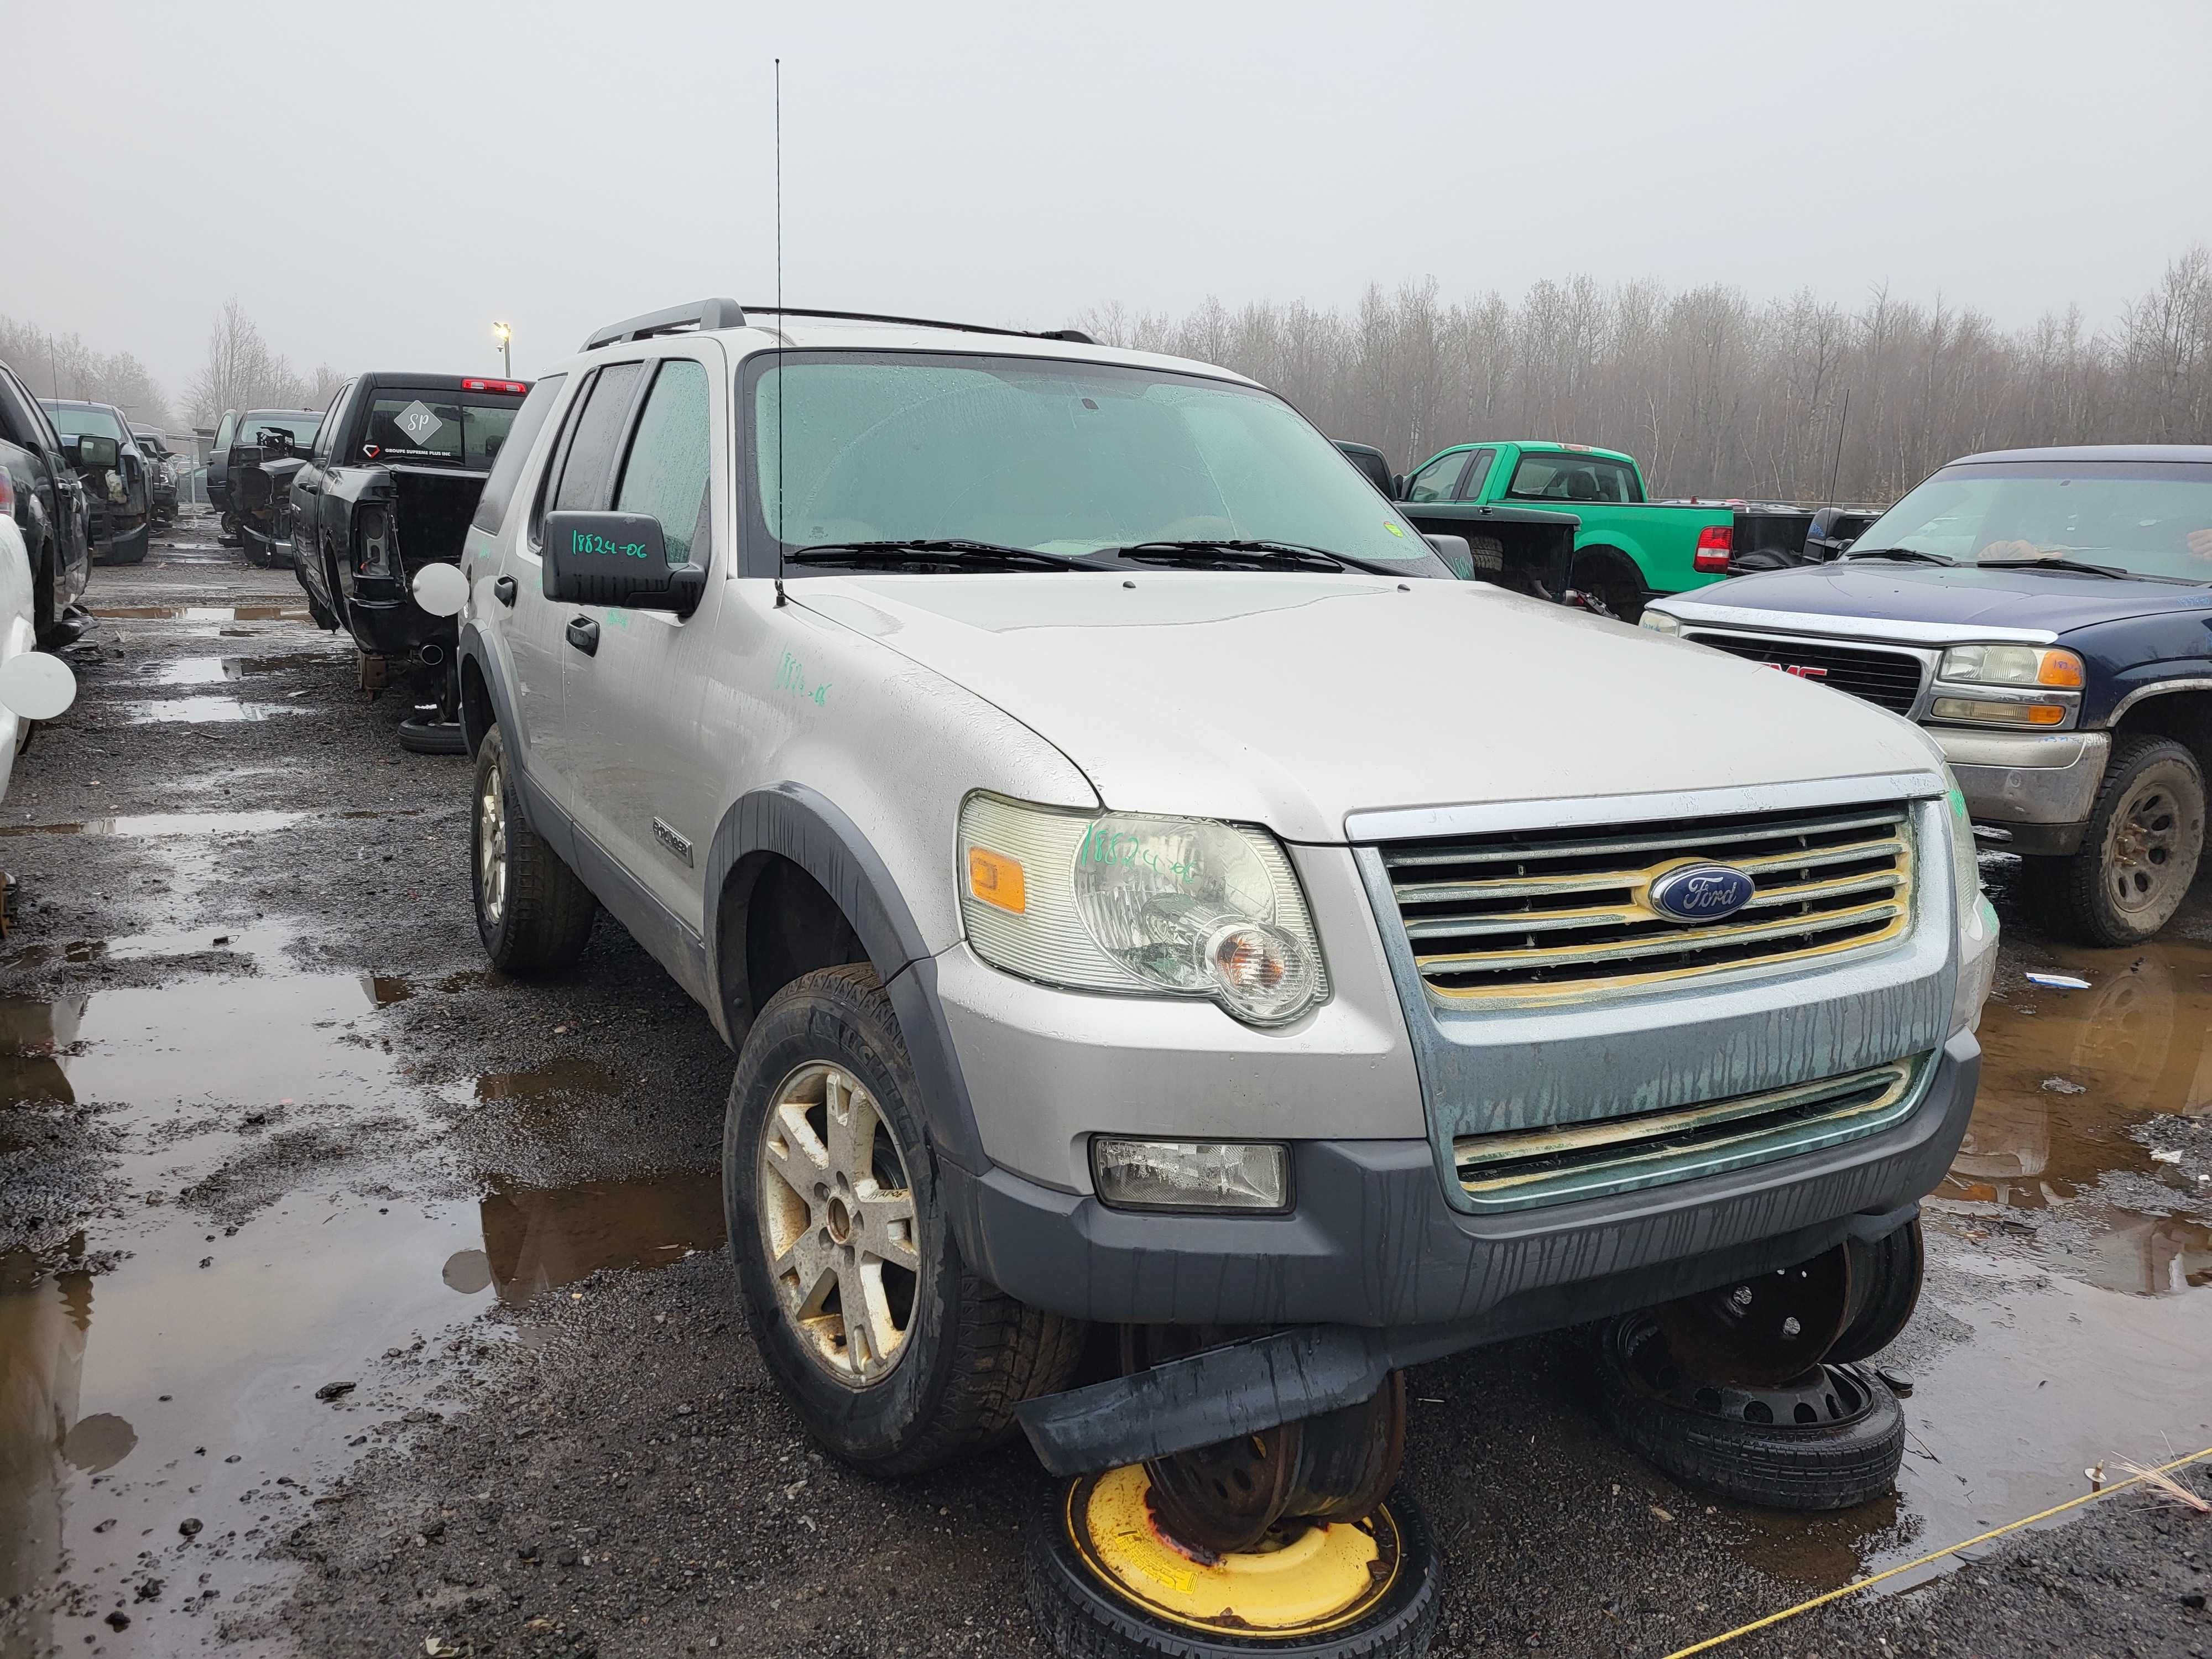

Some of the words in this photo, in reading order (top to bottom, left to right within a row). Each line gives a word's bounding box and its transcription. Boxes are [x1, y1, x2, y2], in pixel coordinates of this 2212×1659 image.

[408, 413, 429, 431] SP
[572, 530, 647, 558] 18824-06
[1683, 876, 1738, 910] Ford
